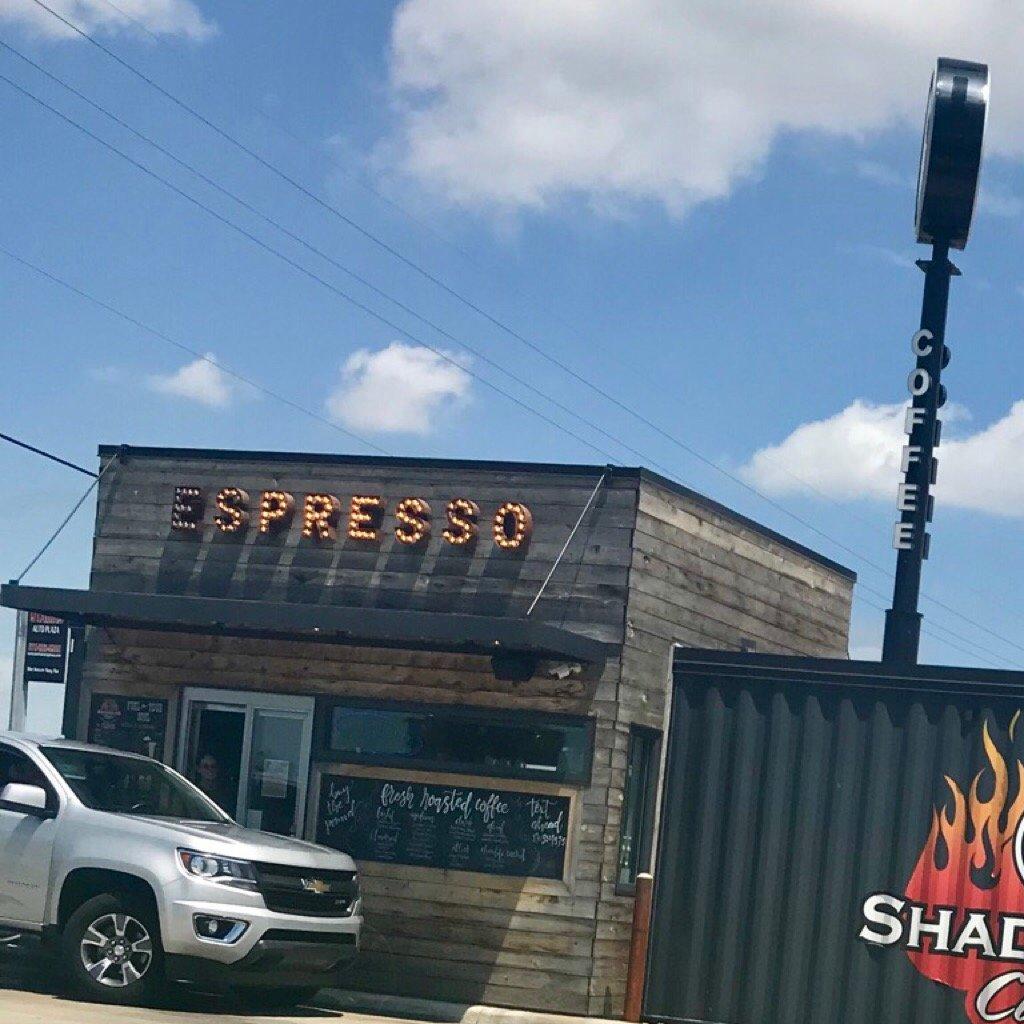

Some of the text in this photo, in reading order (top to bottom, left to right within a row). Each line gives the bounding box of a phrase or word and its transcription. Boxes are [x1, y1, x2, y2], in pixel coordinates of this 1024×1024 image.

[892, 328, 934, 550] COFFEE
[171, 486, 534, 550] ESPRESSO
[475, 792, 510, 824] coffee
